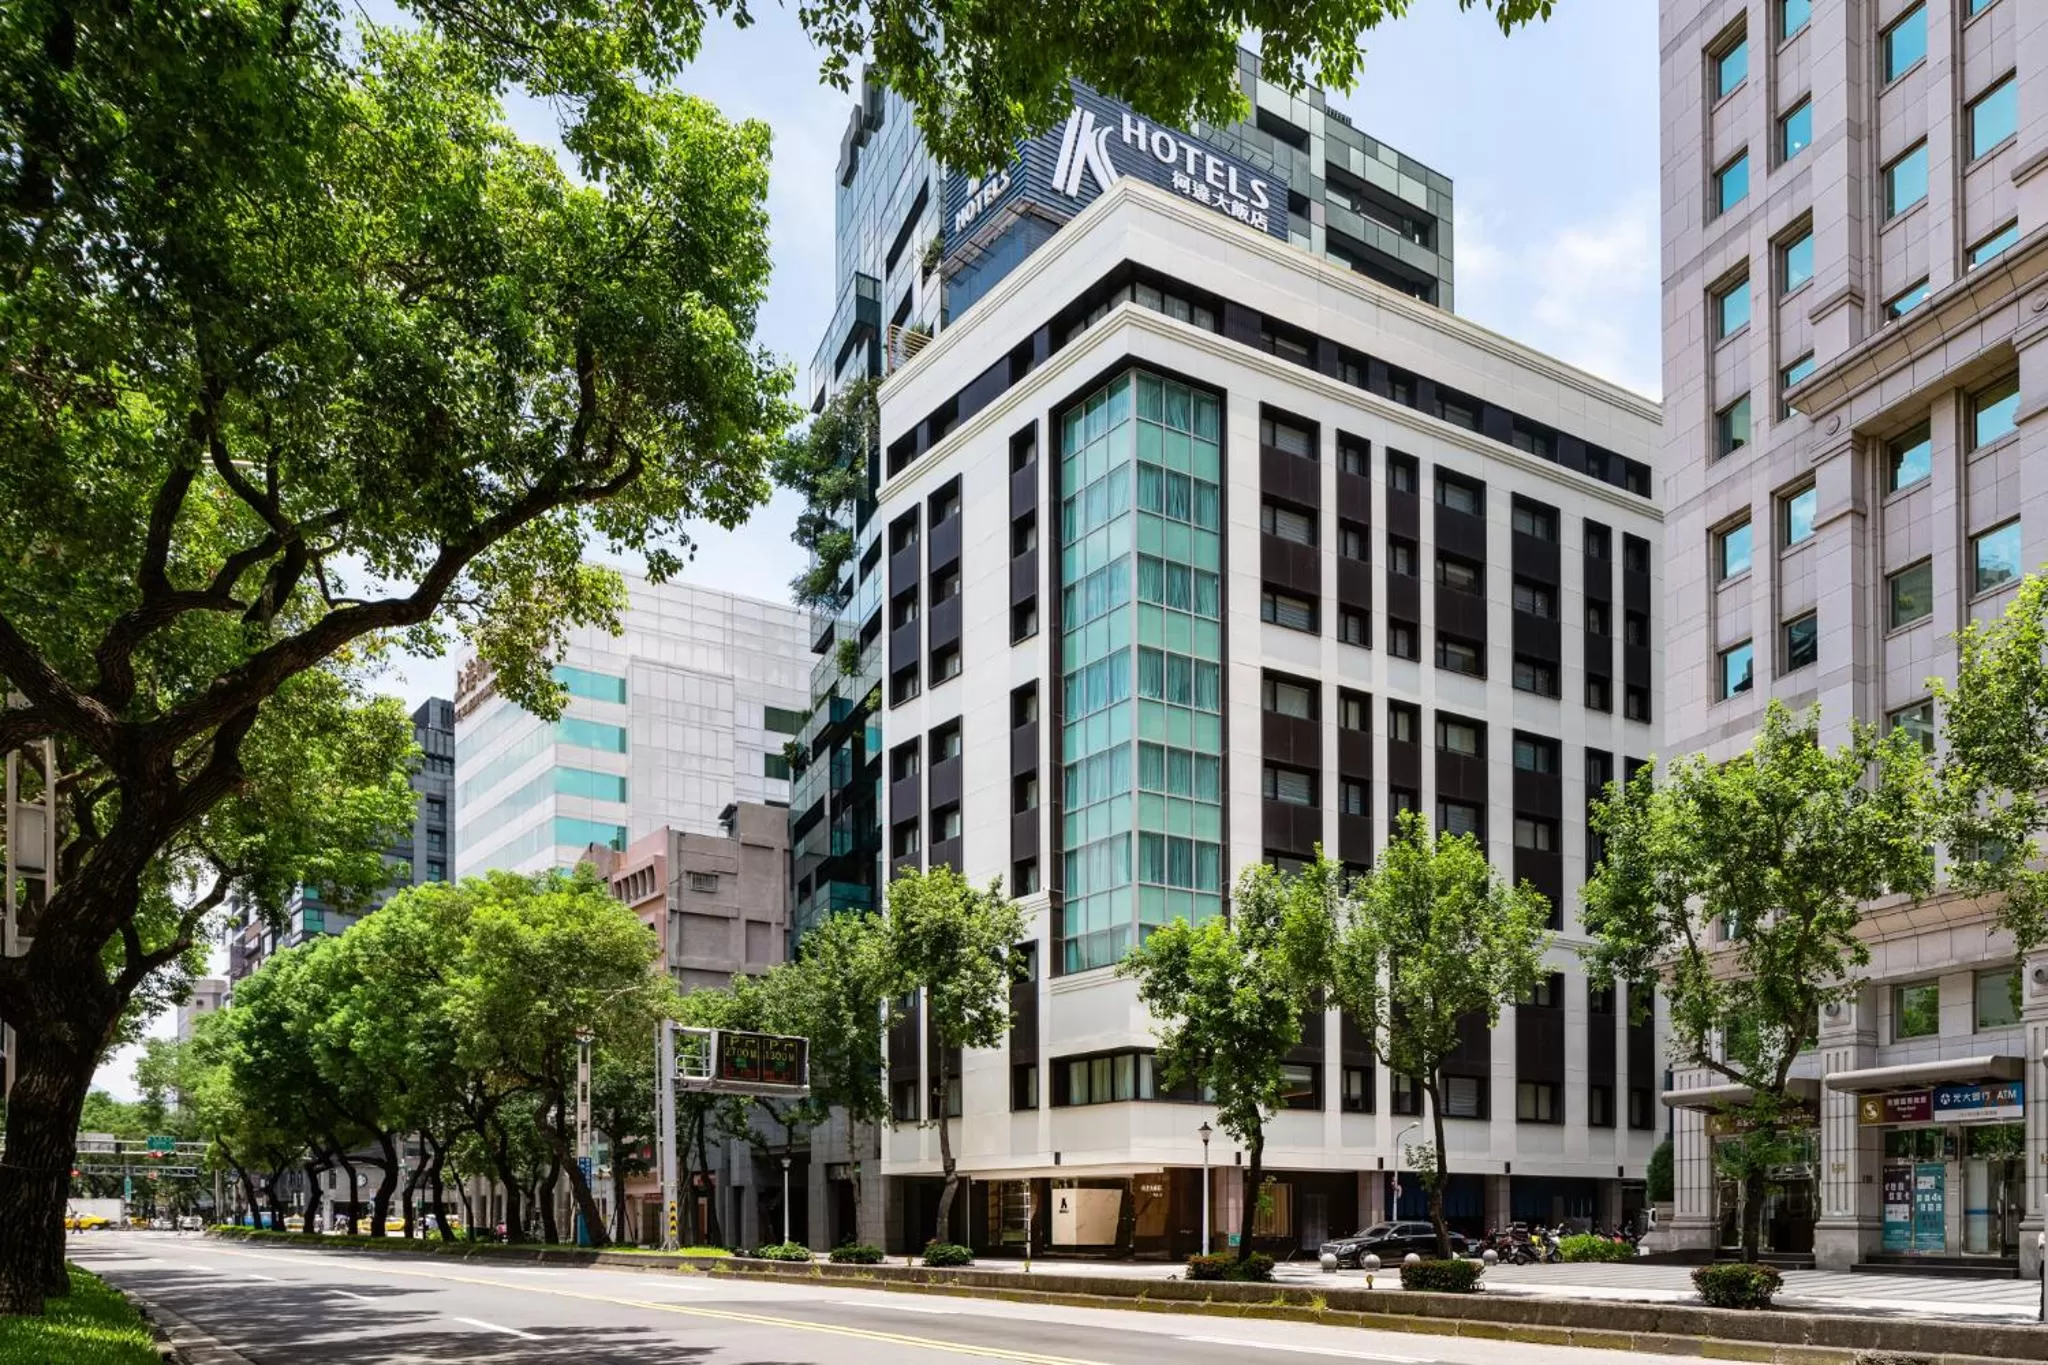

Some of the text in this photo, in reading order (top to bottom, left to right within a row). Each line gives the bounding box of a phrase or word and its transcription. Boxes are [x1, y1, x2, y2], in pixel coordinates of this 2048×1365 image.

[1121, 112, 1270, 210] HOTELS
[955, 168, 1011, 232] HOTELS
[1997, 1088, 2017, 1099] ATM
